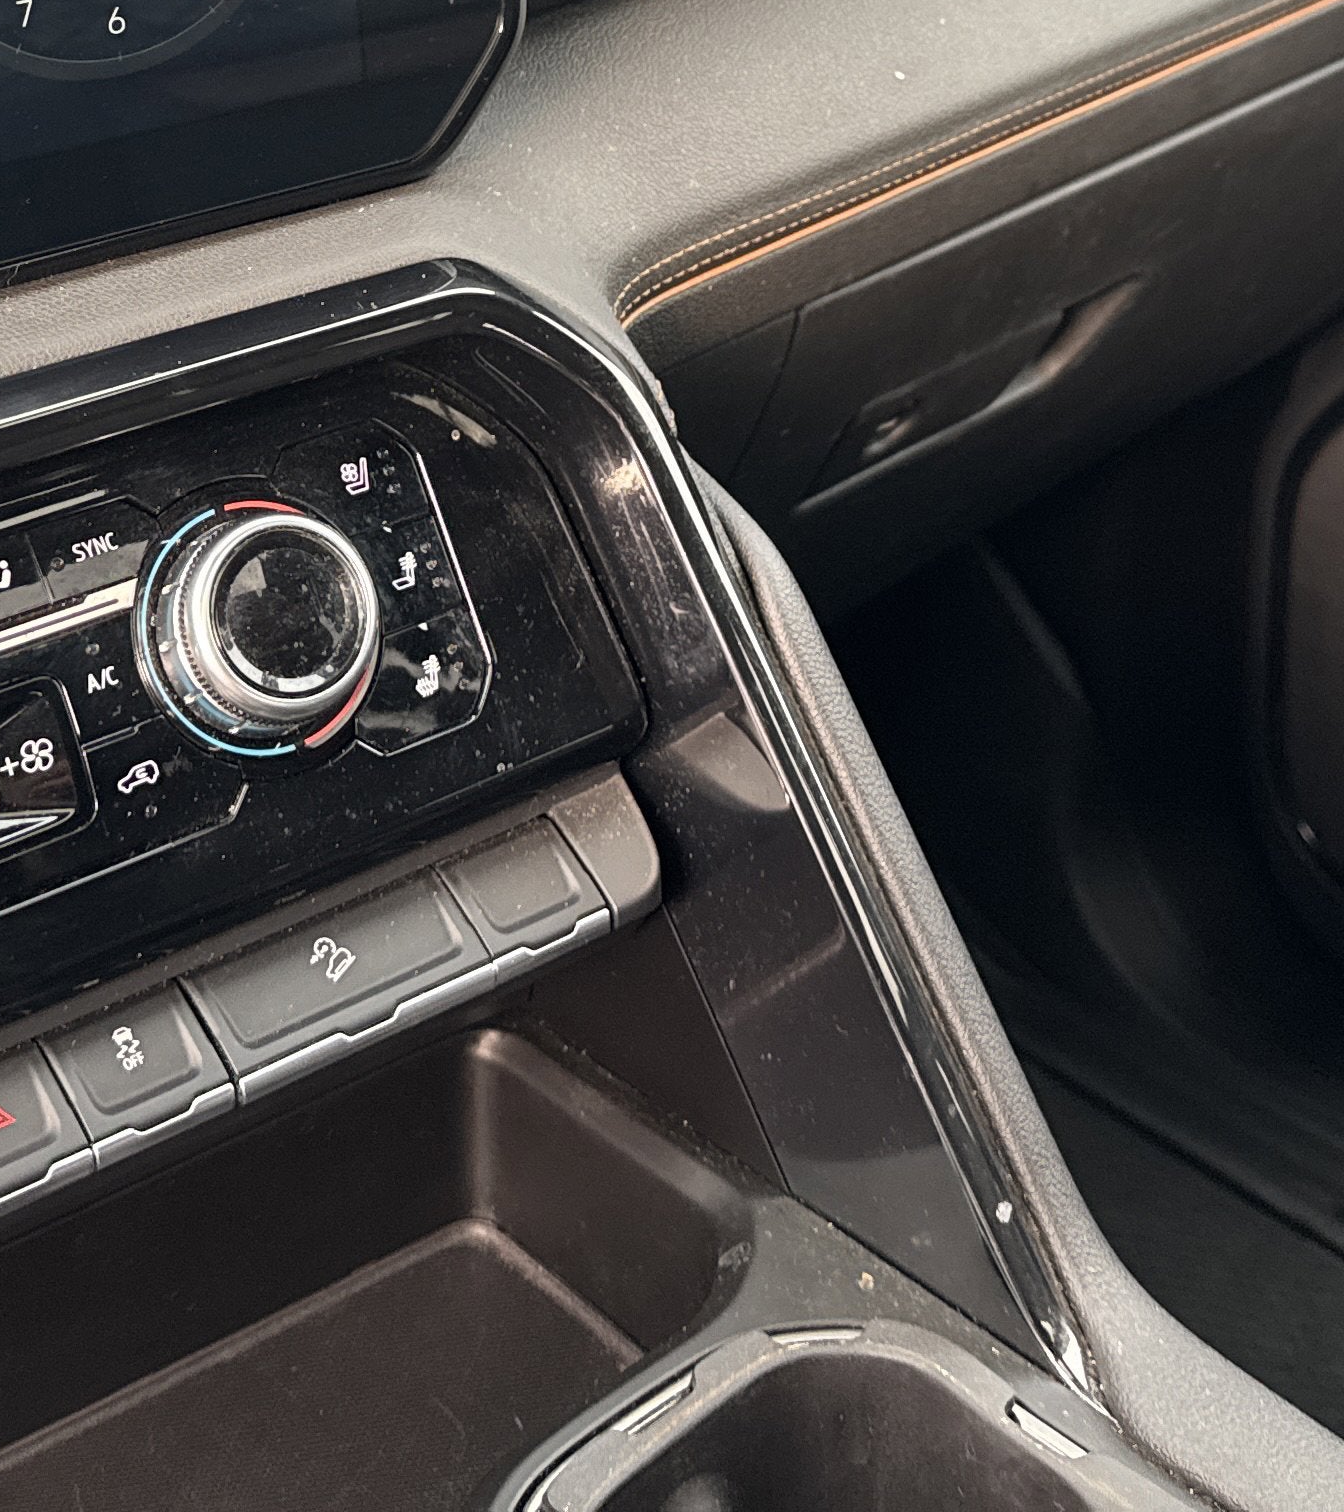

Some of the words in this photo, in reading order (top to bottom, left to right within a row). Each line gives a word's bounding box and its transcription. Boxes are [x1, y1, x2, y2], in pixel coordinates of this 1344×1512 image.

[108, 6, 126, 35] 6
[71, 531, 119, 563] SYNC
[87, 665, 120, 694] A/C
